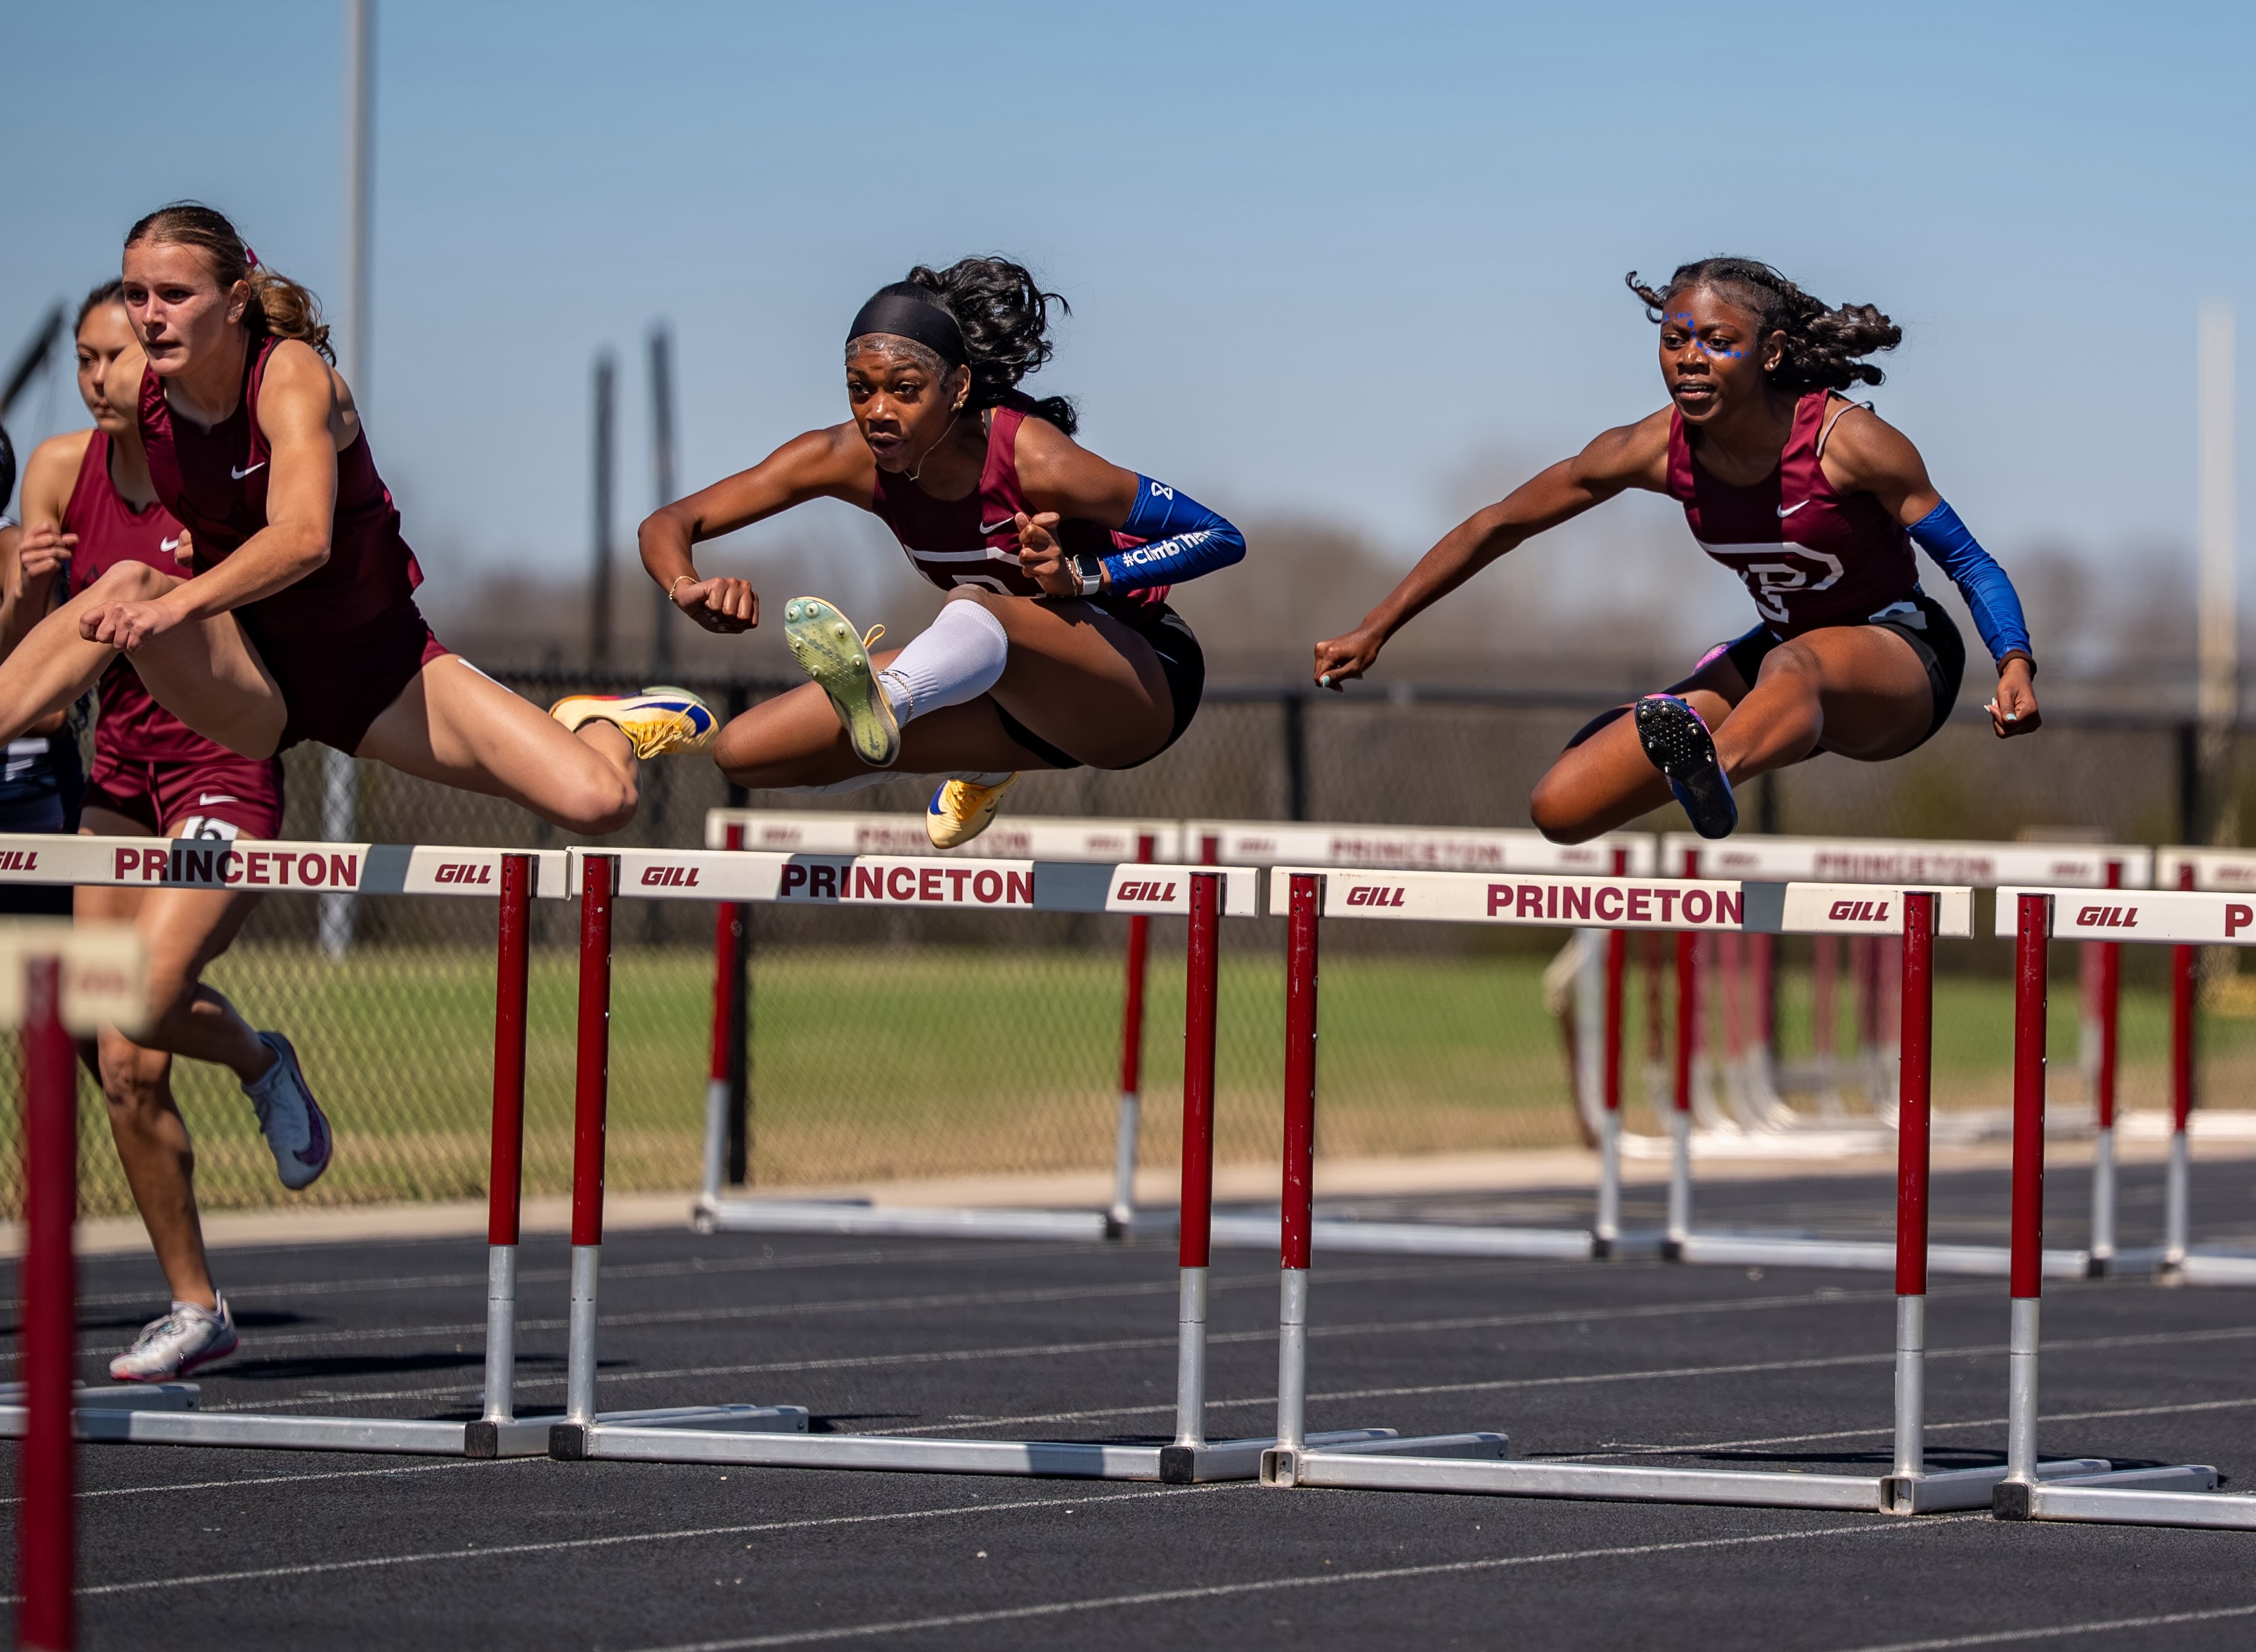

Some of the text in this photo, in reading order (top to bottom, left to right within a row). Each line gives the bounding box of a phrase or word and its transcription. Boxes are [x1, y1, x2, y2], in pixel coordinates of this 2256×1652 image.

[0, 851, 38, 870] ILL
[114, 848, 357, 887] PRINCETON
[435, 864, 491, 884] GILL
[641, 867, 699, 886] GILL
[780, 864, 1035, 905] PRINCETON
[1117, 882, 1176, 902] GILL
[1347, 887, 1405, 906] GILL
[1487, 883, 1745, 925] PRINCETON
[1829, 901, 1889, 921] GILL
[2076, 906, 2138, 927] GILL
